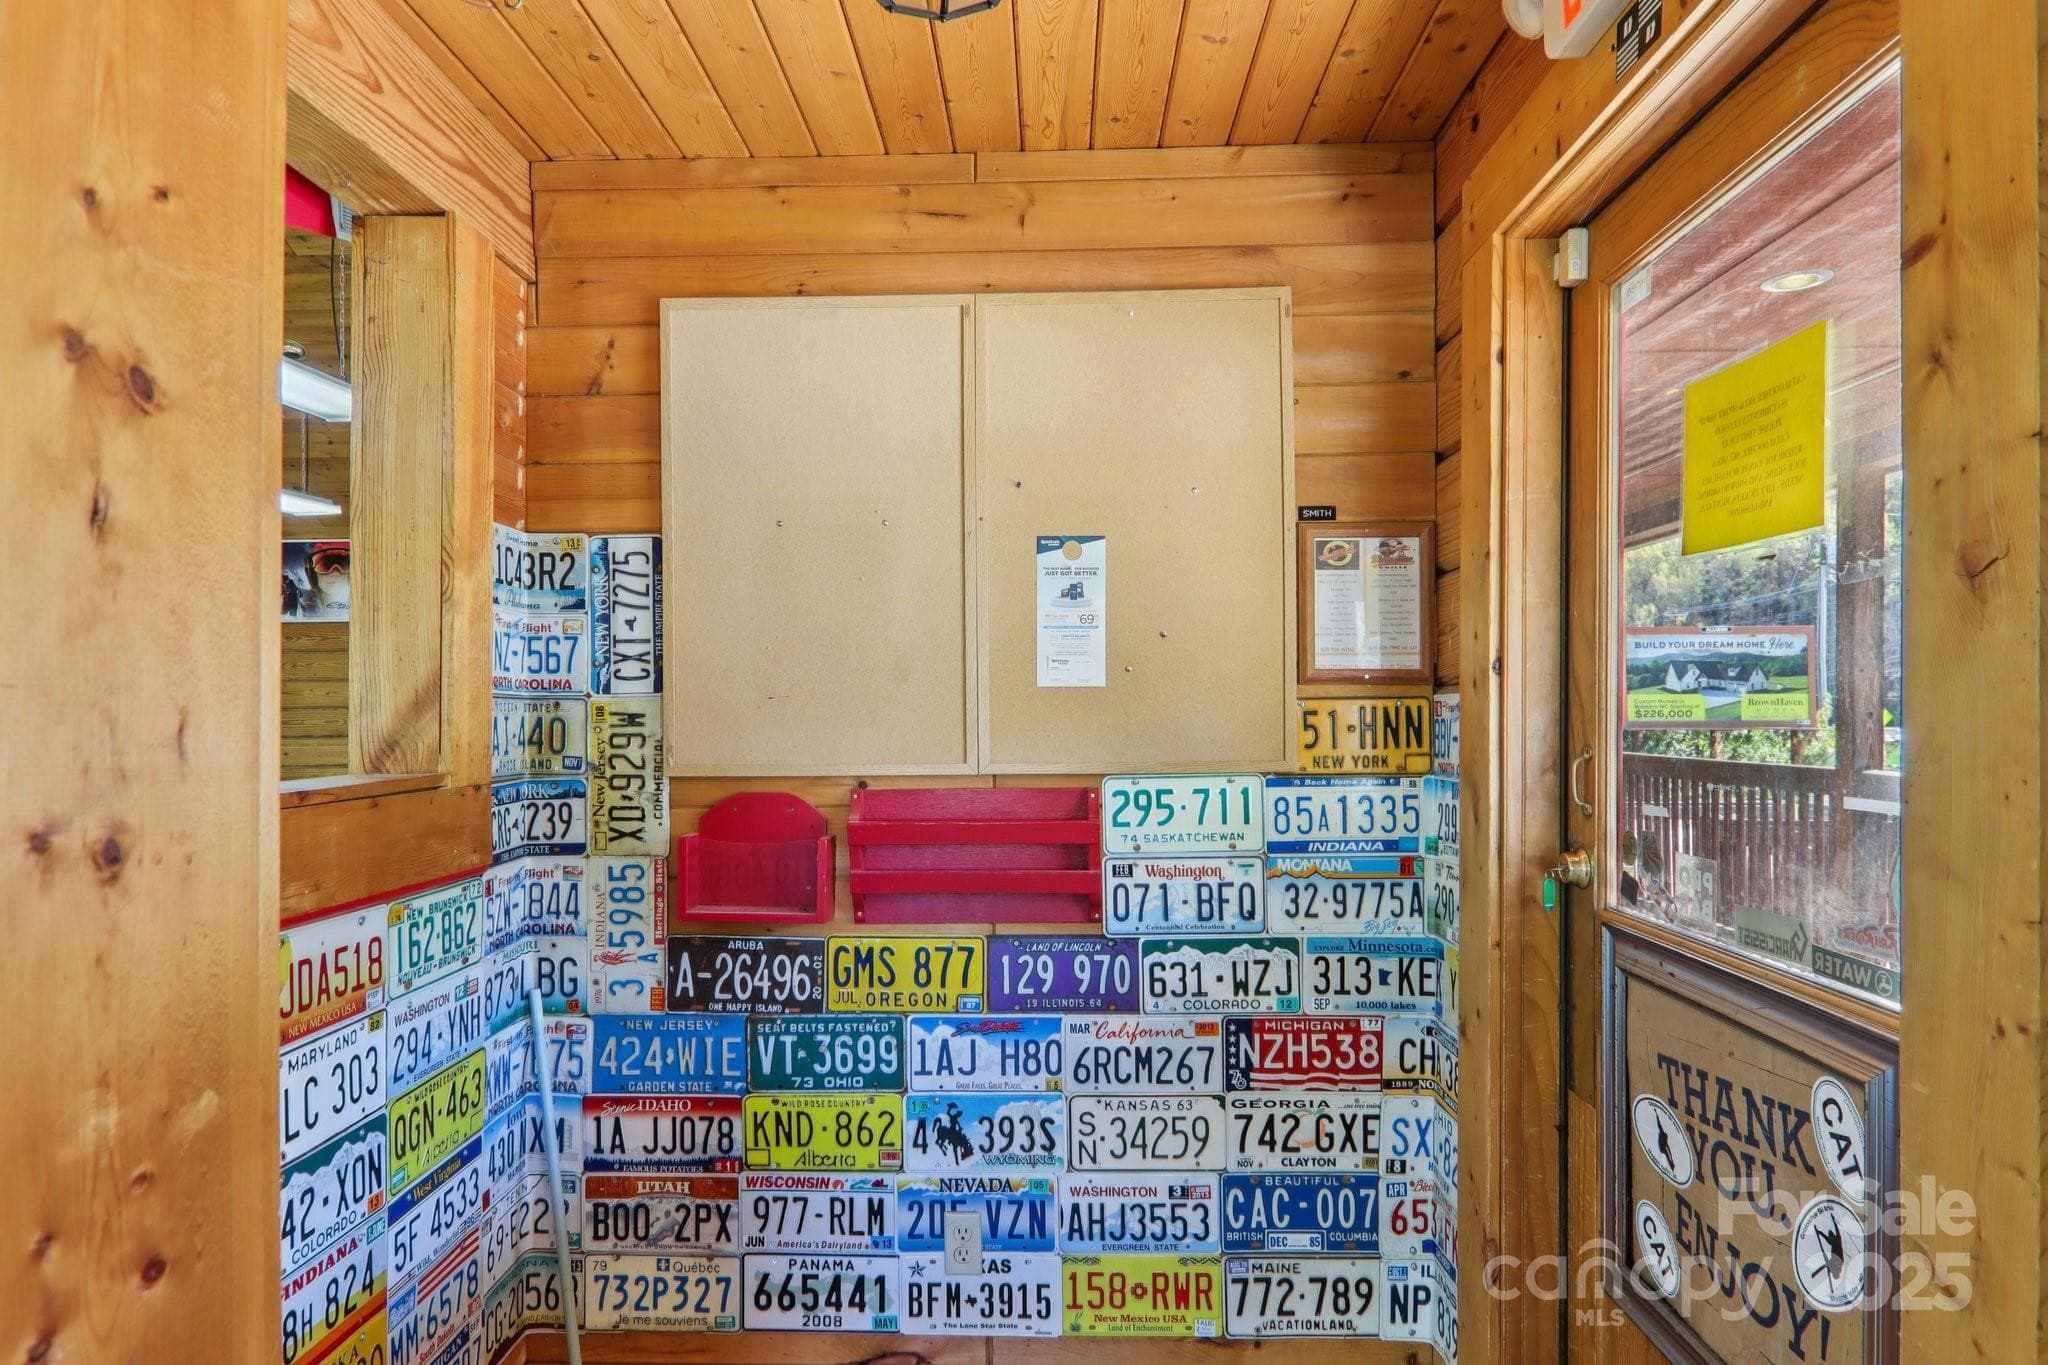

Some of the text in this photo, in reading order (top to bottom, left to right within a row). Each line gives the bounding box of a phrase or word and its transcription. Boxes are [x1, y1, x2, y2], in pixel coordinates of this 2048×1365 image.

[1302, 509, 1332, 518] SMITH
[494, 543, 577, 592] 1C43R2
[612, 550, 651, 682] CXT 7275
[595, 623, 610, 658] NEW
[1634, 636, 1794, 652] BUILD YOUR DREAM HOME Here
[1634, 709, 1694, 720] $226,000
[1747, 698, 1804, 707] BrownHaven
[607, 711, 646, 792] 929W
[1312, 754, 1390, 769] NEW YORK
[592, 736, 609, 817] New Jersey
[519, 802, 573, 842] 3239
[1120, 831, 1246, 844] 74 SASKATCHEWAN
[1307, 840, 1385, 853] INDIANA
[1144, 863, 1226, 882] Washington
[1275, 857, 1354, 874] MONTANA
[406, 893, 470, 923] NEW BRUNSWICK
[607, 863, 647, 949] 5985
[727, 939, 765, 951] ARUBA
[279, 935, 384, 1020] JDA518
[674, 951, 812, 1002] A-26496
[832, 944, 976, 990] GMS 877
[1000, 954, 1132, 996] 129 970
[287, 1002, 358, 1039] NEW MEXICO USA
[393, 992, 451, 1028] WASHINGTON
[1182, 998, 1262, 1011] COLORADO
[626, 1019, 714, 1031] NEW JERSEY
[757, 1020, 897, 1033] SEAT BELTS FASTENED?
[1069, 1020, 1196, 1046] MAR California
[1264, 1020, 1345, 1032] MICHIGAN
[287, 1029, 357, 1075] MARYLAND
[600, 1035, 742, 1077] 424 WIE
[757, 1034, 898, 1076] VT 3699
[913, 1038, 977, 1078] 1AJ
[1072, 1046, 1215, 1085] 6RCM267
[1238, 1032, 1380, 1071] NZH538
[284, 1045, 378, 1144] LC 303
[628, 1081, 712, 1093] GARDEN STATE
[1103, 1099, 1194, 1112] KANSAS 63
[1230, 1099, 1331, 1110] GEORGIA
[600, 1099, 692, 1118] Scenic IDAHO
[1656, 1052, 1816, 1177] THANK
[592, 1116, 626, 1155] 1A
[911, 1116, 929, 1155] 4
[1109, 1115, 1211, 1161] 34259
[1233, 1112, 1381, 1154] 742 GXE
[1822, 1096, 1864, 1181] CAT
[793, 1153, 857, 1168] Alberta
[981, 1153, 1057, 1166] WYOMING
[1280, 1156, 1338, 1168] CLAYTON
[635, 1180, 690, 1194] UTAH
[745, 1176, 831, 1190] WISCONSIN
[938, 1177, 1015, 1194] NEVADA
[1069, 1186, 1158, 1198] WASHINGTON
[1264, 1175, 1340, 1187] BEAUTIFUL
[393, 1166, 480, 1273] 5F 4533
[674, 1203, 732, 1243] 2PX
[753, 1196, 885, 1237] 977-RLM
[1067, 1201, 1211, 1243] AHJ3553
[1226, 1187, 1377, 1230] CAC-007
[291, 1210, 357, 1265] COLORADO
[1226, 1231, 1379, 1242] BRITISH COLUMBIA
[1269, 1234, 1321, 1249] DEC 85
[1643, 1215, 1675, 1277] CAT
[281, 1236, 359, 1302] INDIANA
[592, 1259, 721, 1275] 79 Québec
[788, 1258, 855, 1272] PANAMA
[1251, 1261, 1302, 1275] MAINE
[1674, 1190, 1831, 1362] ENJOY!
[282, 1248, 375, 1365] 8H 824
[593, 1274, 733, 1315] 732P327
[753, 1272, 887, 1315] 665441
[907, 1281, 1052, 1320] BFM 3915
[1065, 1271, 1214, 1312] 158 RWR
[801, 1314, 843, 1328] 2008
[1261, 1318, 1354, 1331] VACATIONLAND
